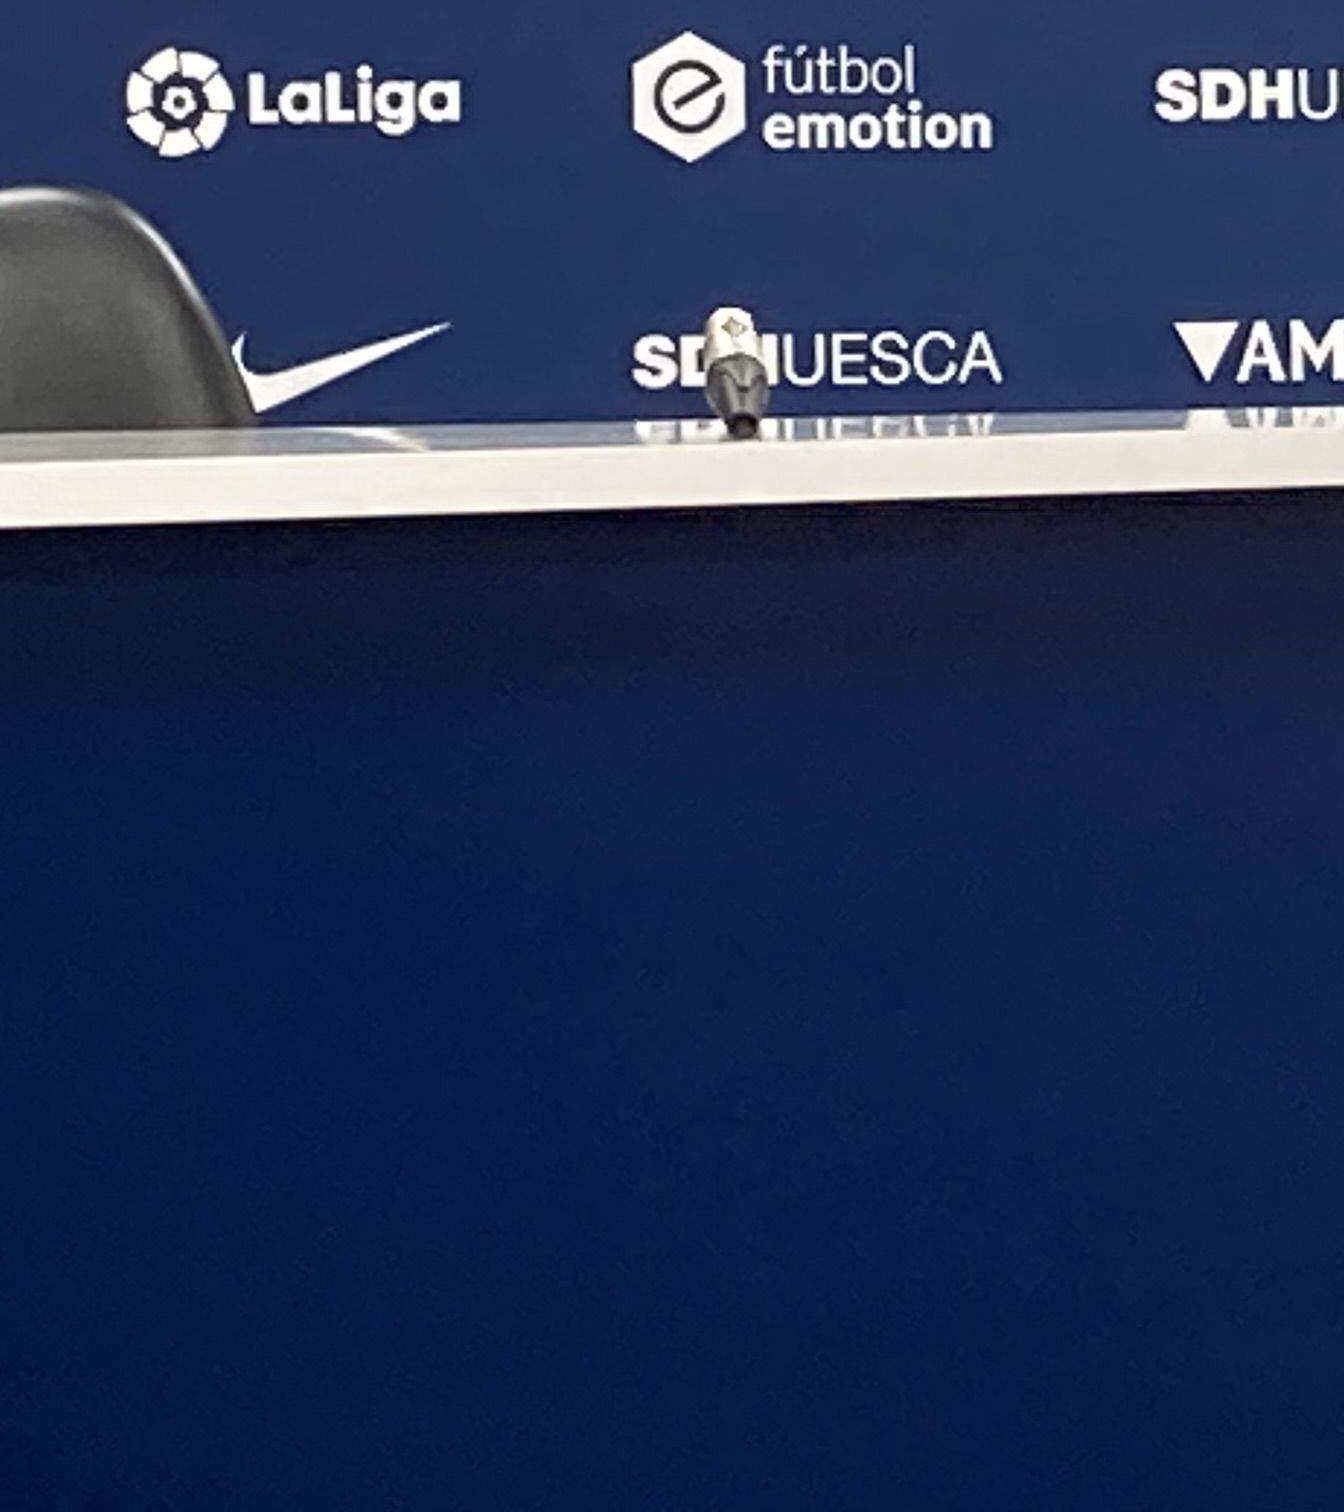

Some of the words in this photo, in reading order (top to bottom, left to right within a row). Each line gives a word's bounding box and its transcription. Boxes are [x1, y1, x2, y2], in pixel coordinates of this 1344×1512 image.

[762, 44, 916, 97] fútbol
[248, 64, 461, 136] LaLiga
[762, 99, 992, 149] emotion
